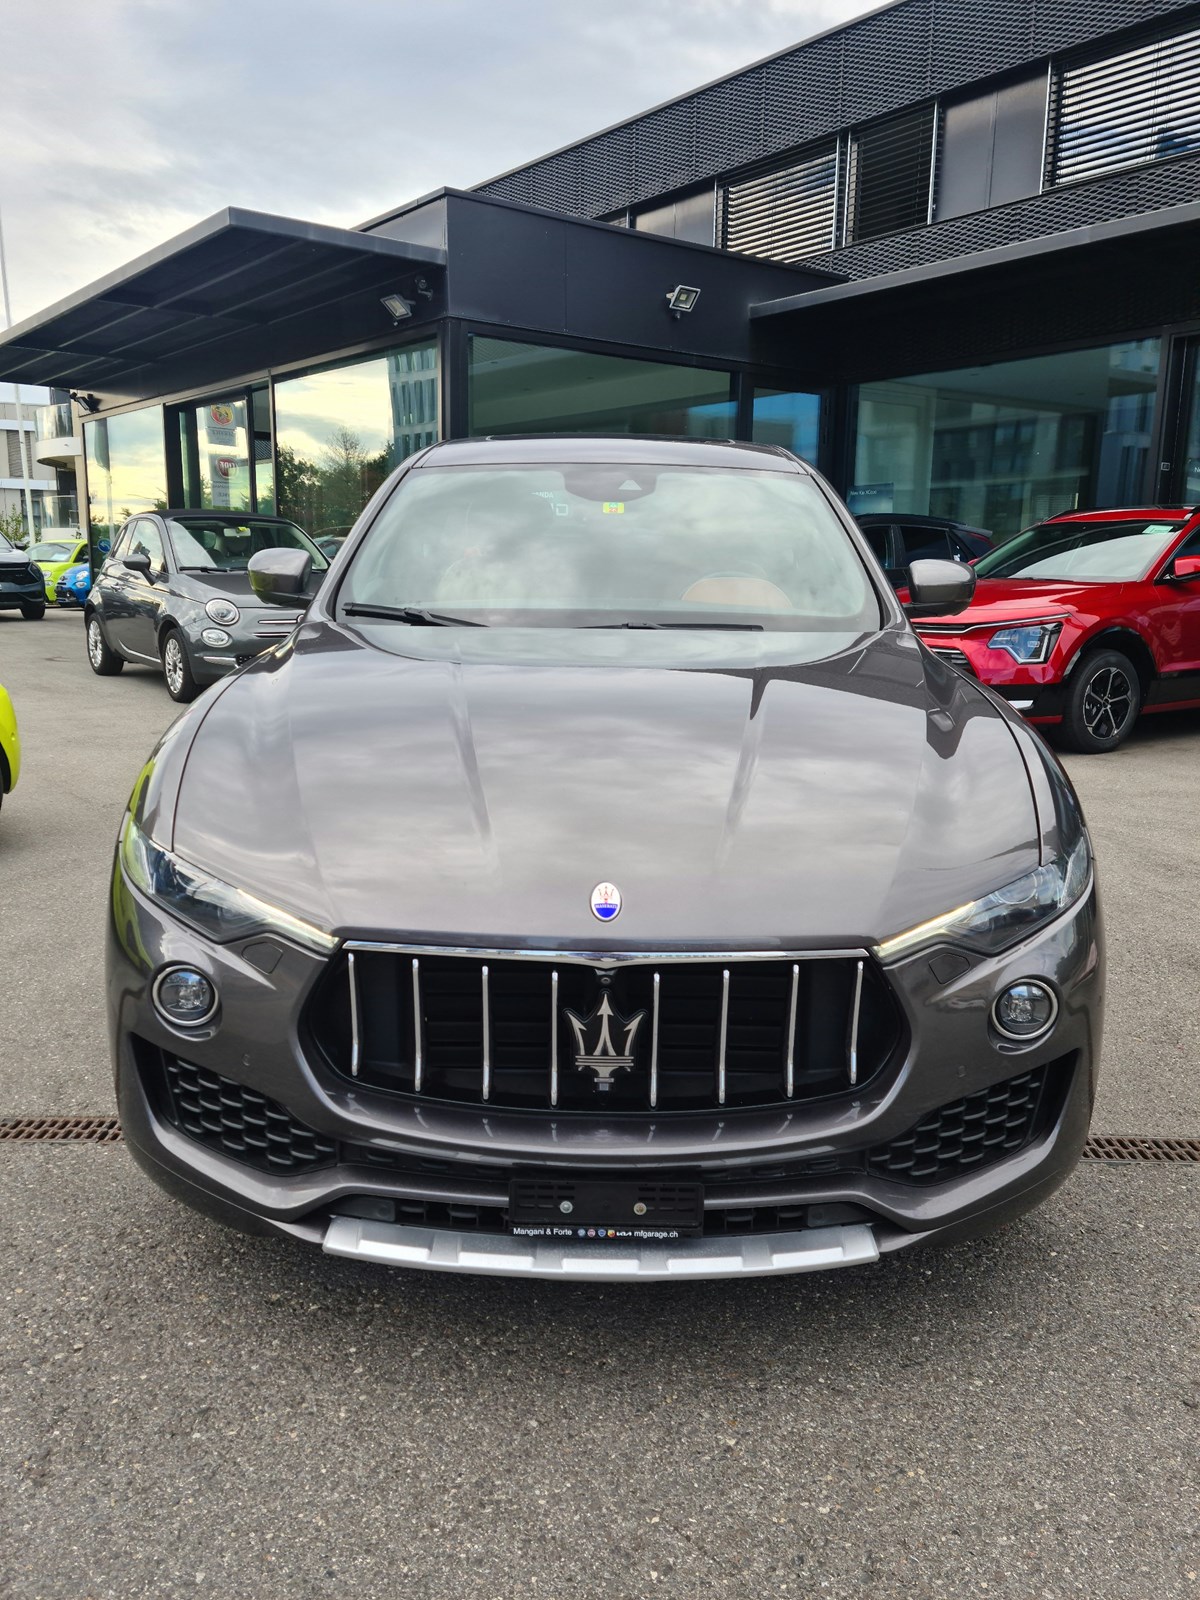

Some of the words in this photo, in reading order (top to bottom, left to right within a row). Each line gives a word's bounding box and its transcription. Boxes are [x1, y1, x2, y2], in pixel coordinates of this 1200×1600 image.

[513, 1227, 544, 1236] Mangani
[553, 1228, 572, 1236] Forte
[634, 1230, 678, 1239] mfgarage.ch
